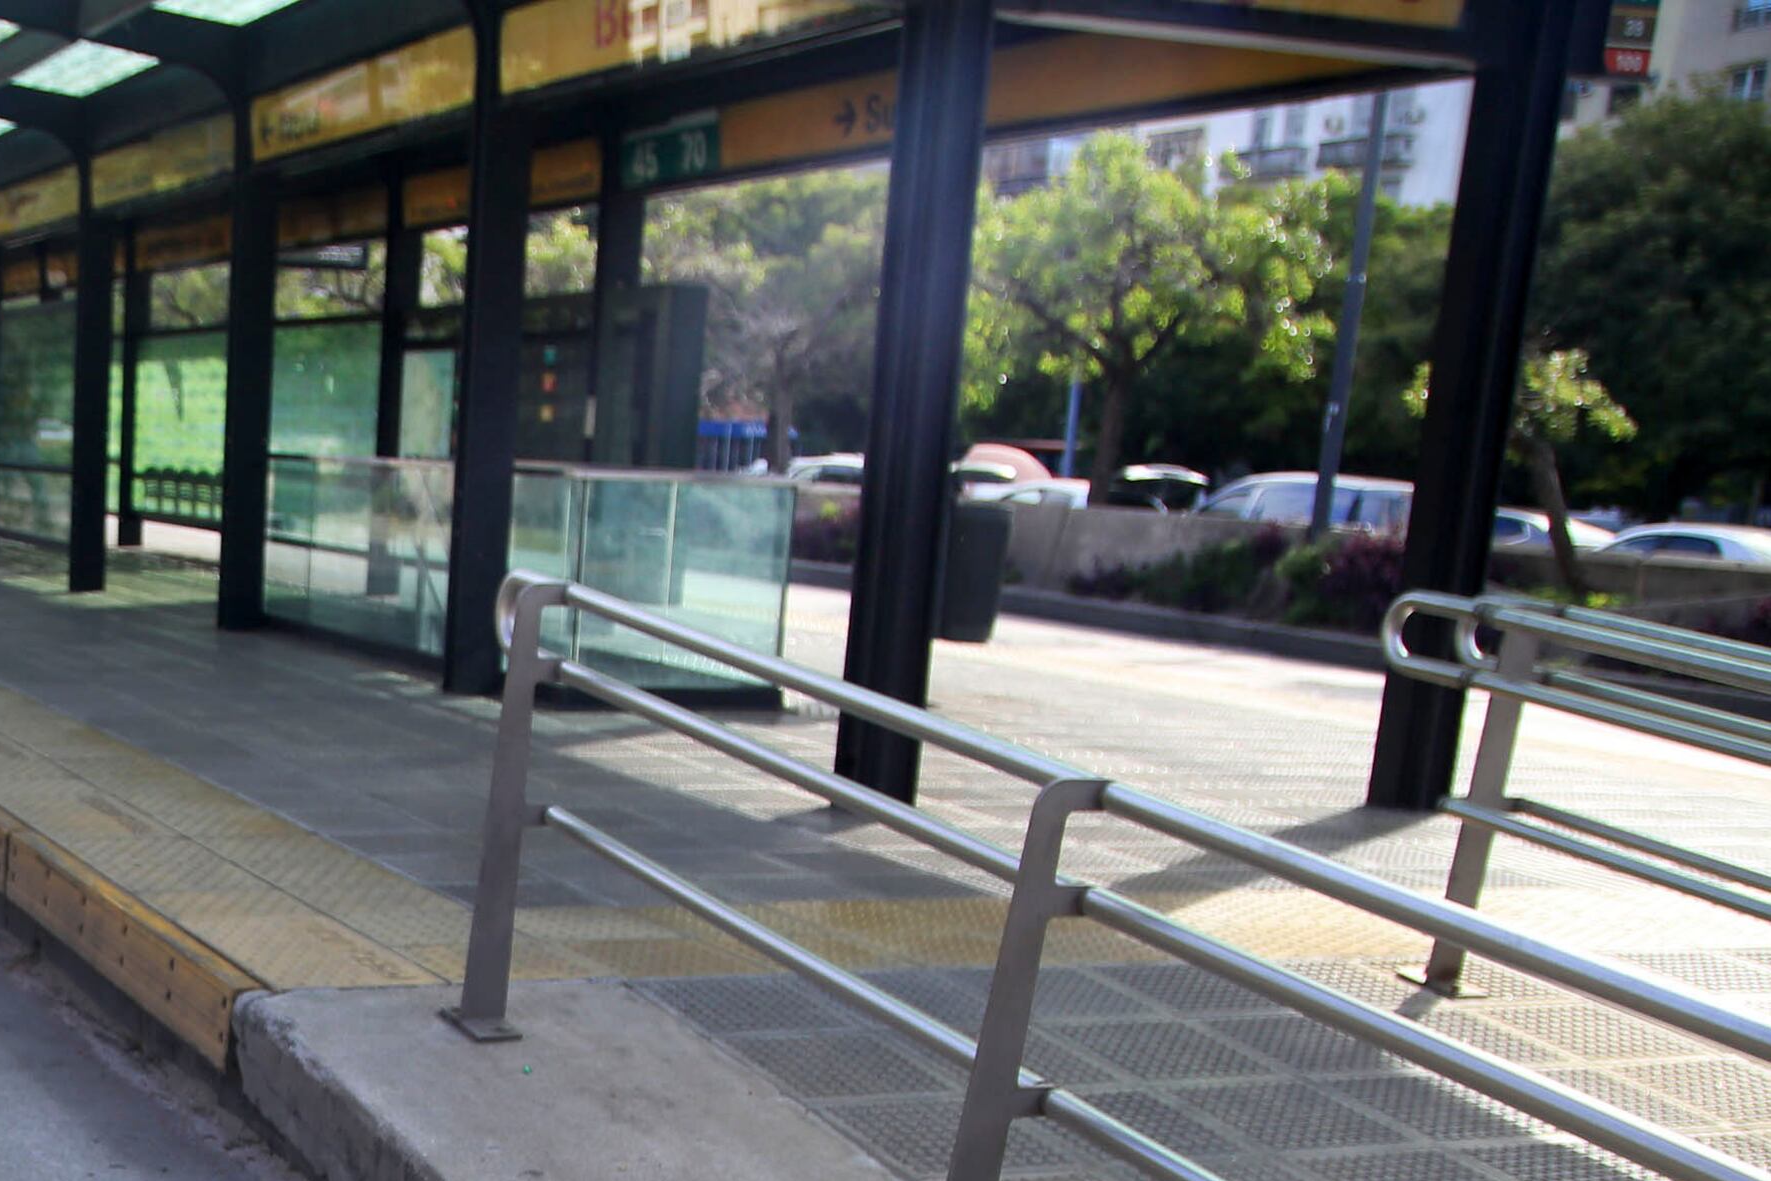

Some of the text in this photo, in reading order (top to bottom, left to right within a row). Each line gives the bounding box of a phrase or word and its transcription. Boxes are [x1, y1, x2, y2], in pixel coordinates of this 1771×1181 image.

[865, 93, 898, 134] Su
[632, 142, 659, 179] 45
[679, 129, 707, 173] 70
